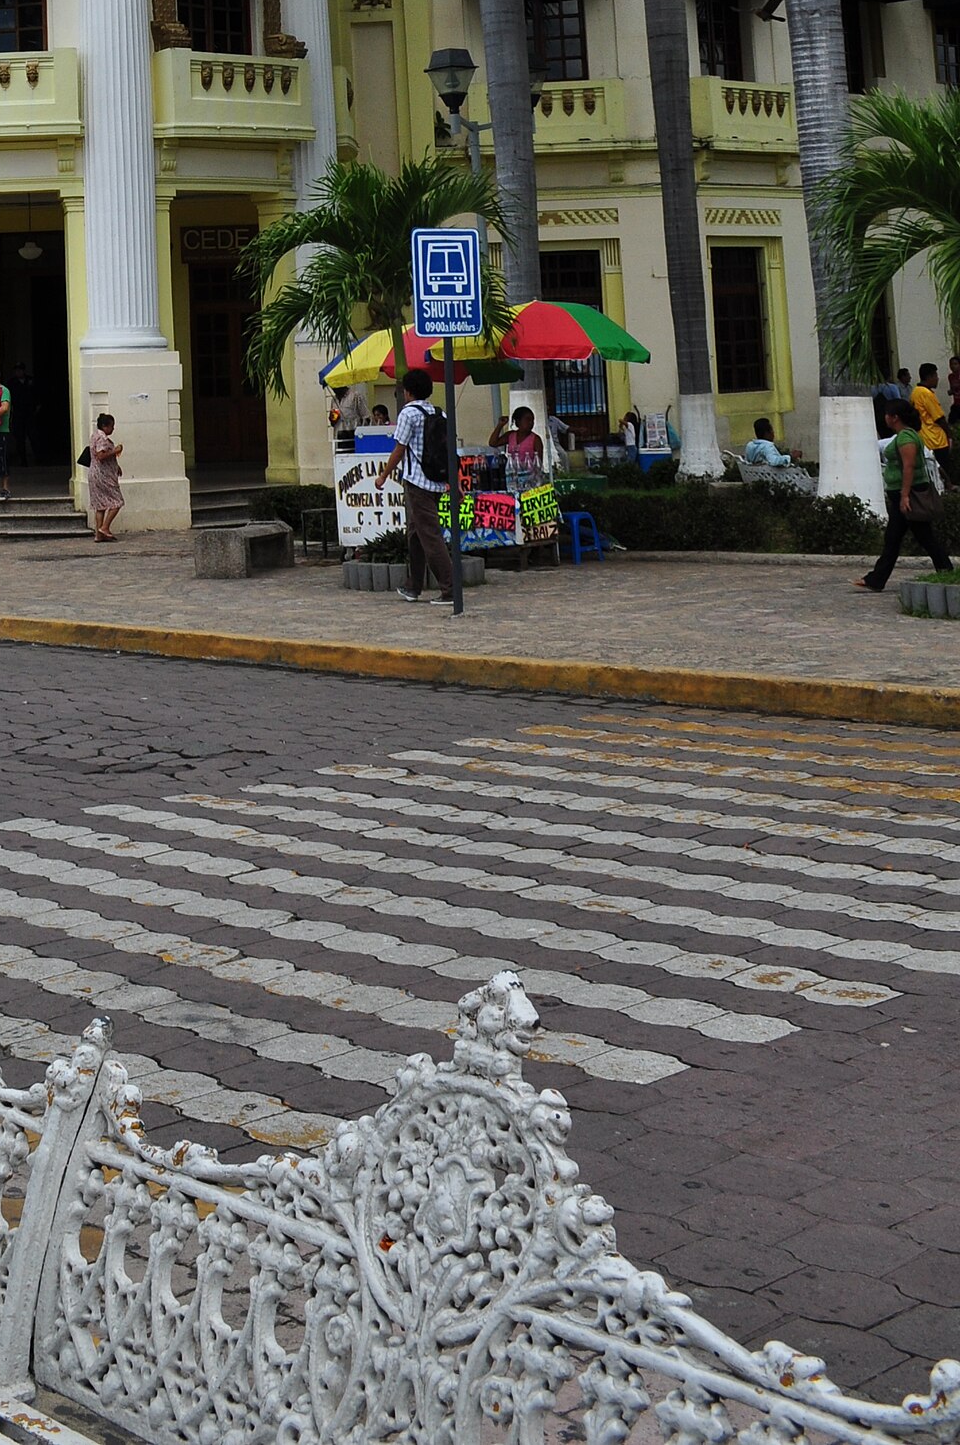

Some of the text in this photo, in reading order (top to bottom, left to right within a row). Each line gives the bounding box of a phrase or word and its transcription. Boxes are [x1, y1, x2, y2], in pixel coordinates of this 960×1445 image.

[422, 300, 473, 319] SHUTTLE
[365, 460, 377, 477] LA
[345, 493, 374, 507] CERVEZA
[375, 493, 384, 507] DE
[475, 499, 516, 516] CERVEZA
[521, 490, 557, 513] CERVEZA
[475, 515, 516, 531] DE RAIZ
[523, 505, 560, 528] DE RAIZ
[533, 524, 558, 540] RAIZ
